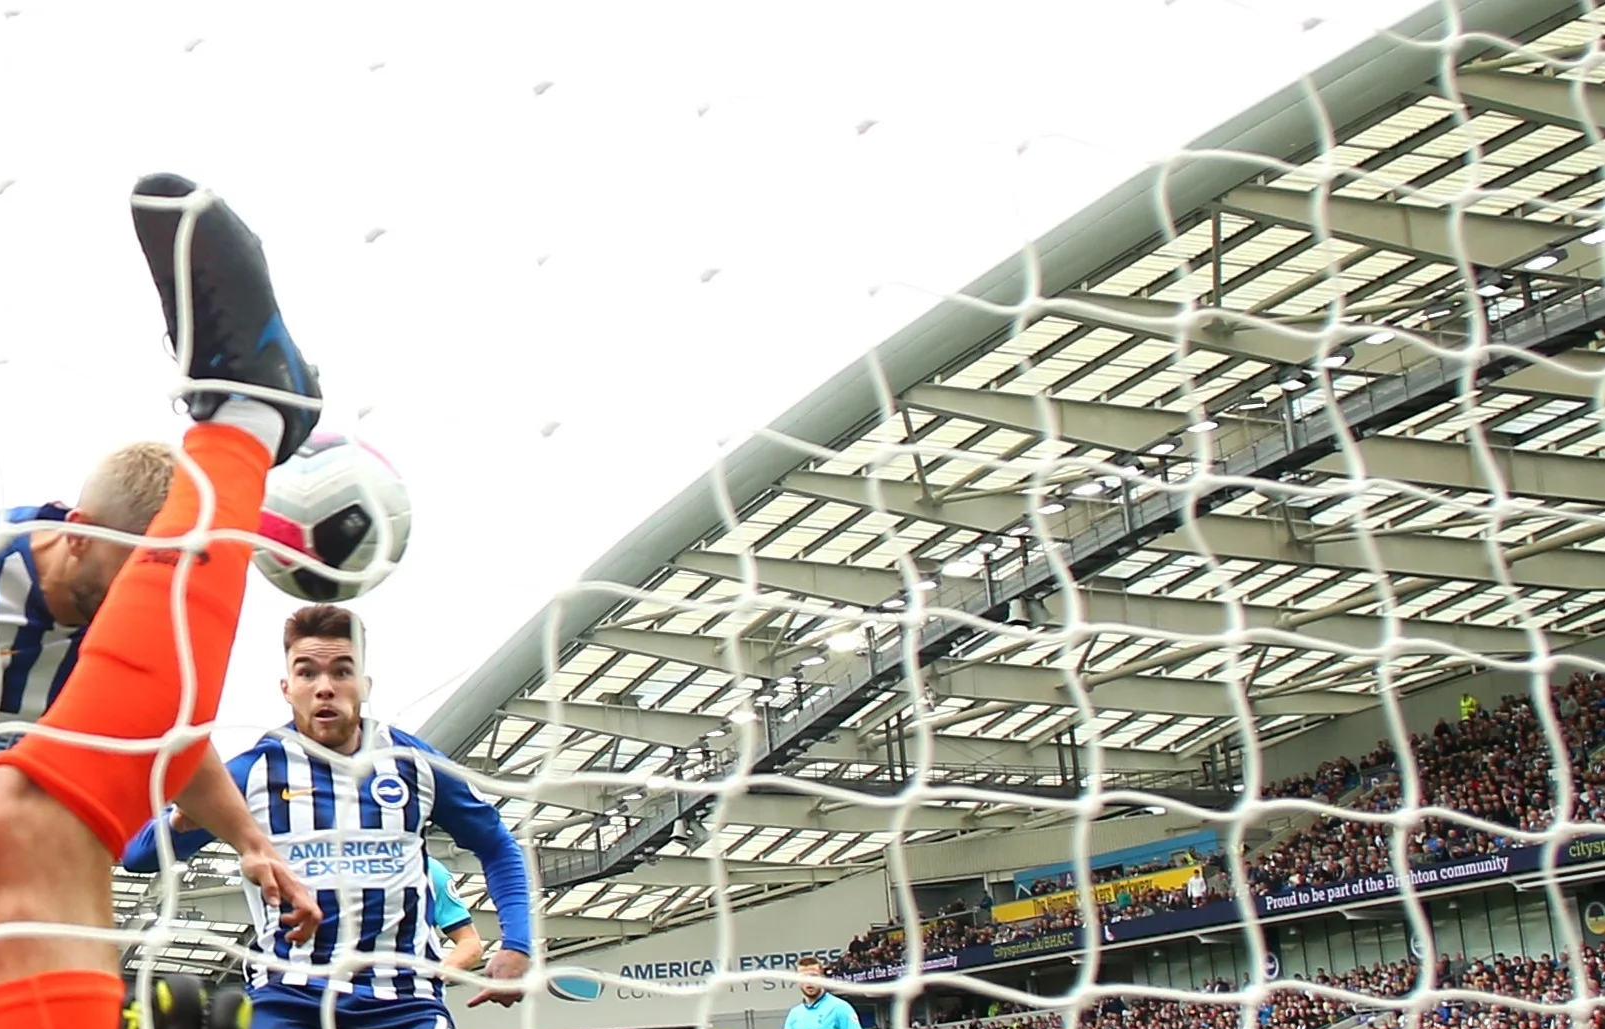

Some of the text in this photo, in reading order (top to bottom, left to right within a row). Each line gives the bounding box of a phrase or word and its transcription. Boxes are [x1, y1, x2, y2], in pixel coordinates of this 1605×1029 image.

[290, 841, 404, 861] AMERICAN
[306, 858, 405, 877] EXPRESS
[1266, 856, 1509, 910] Proud to be part of the Brhton community
[620, 959, 730, 980] AMERICA
